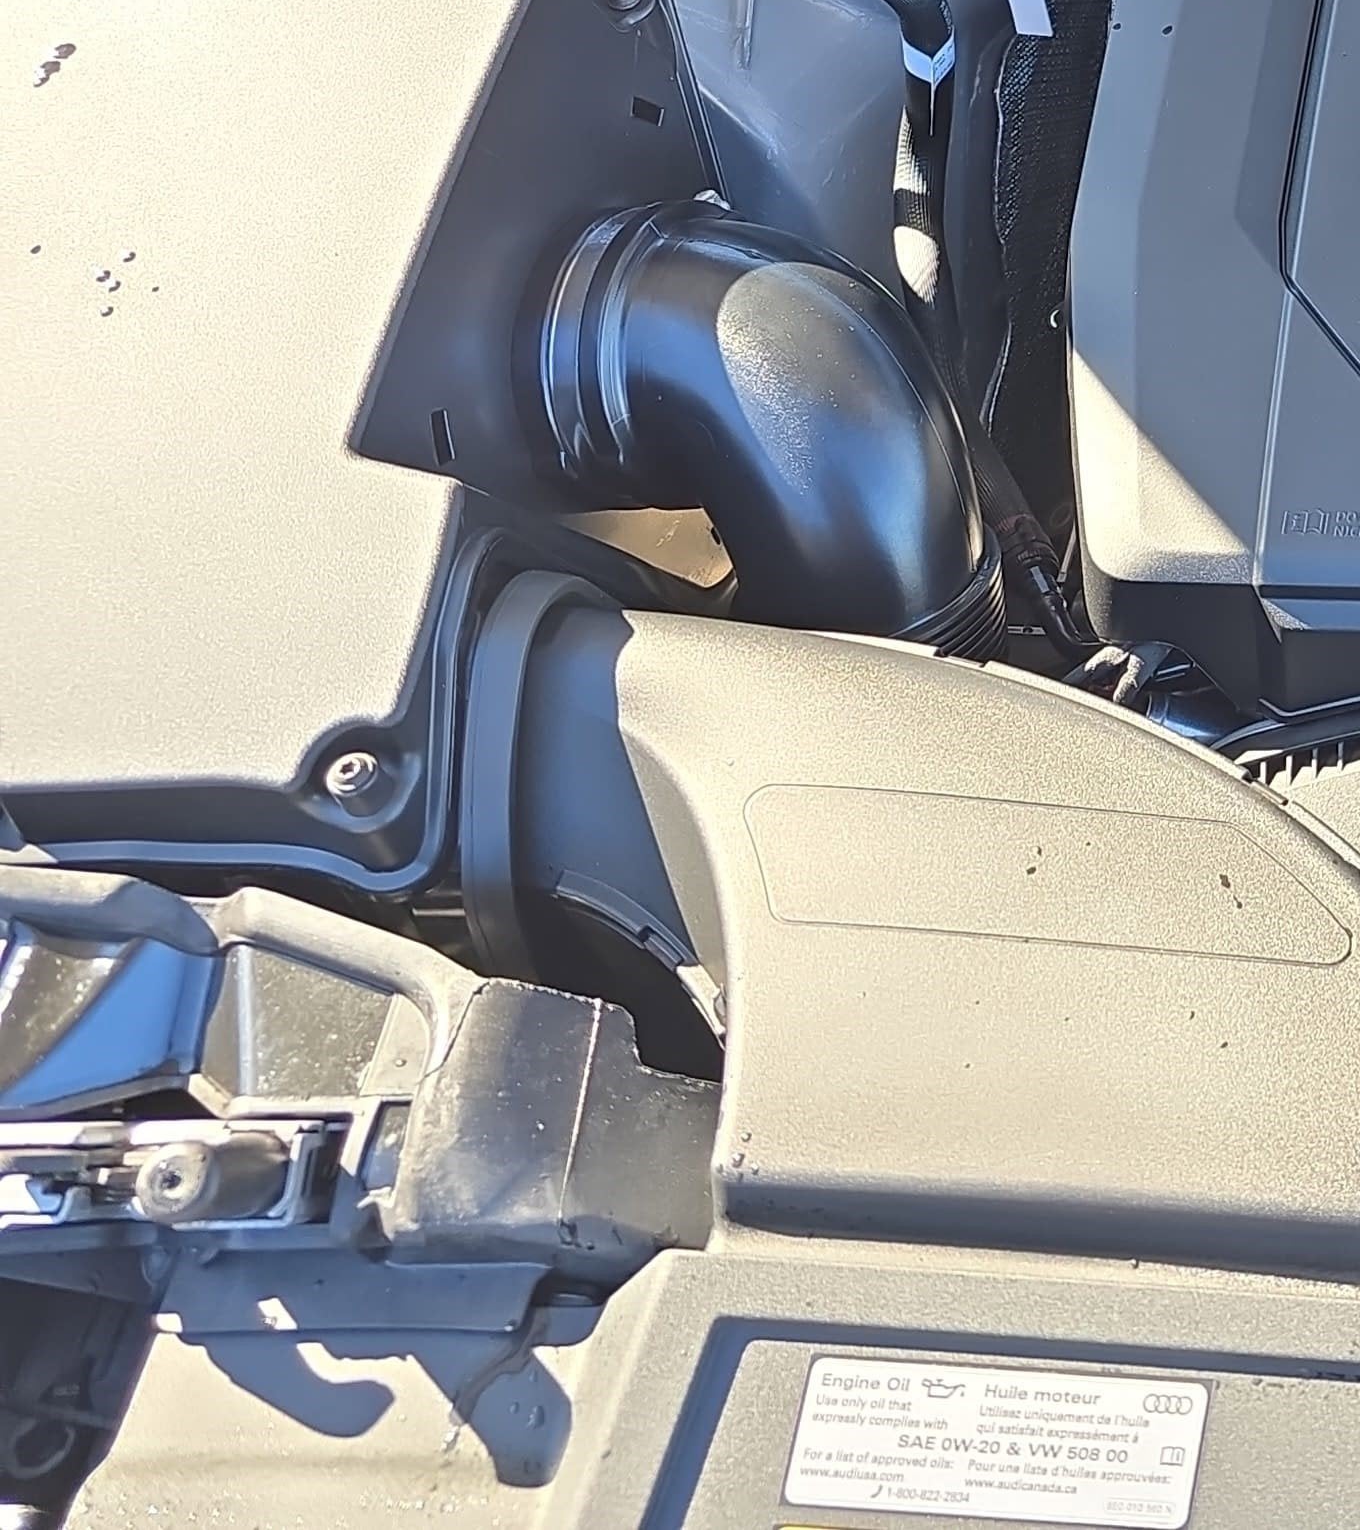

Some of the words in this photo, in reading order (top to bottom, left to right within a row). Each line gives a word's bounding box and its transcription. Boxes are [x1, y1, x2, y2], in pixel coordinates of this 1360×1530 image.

[1335, 511, 1357, 524] DO
[821, 1373, 881, 1391] Engine
[887, 1376, 911, 1392] Oil
[816, 1394, 838, 1407] Use
[841, 1398, 866, 1410] only
[870, 1398, 886, 1409] oil
[888, 1400, 913, 1412] that
[984, 1384, 1028, 1401] Huile
[1034, 1389, 1101, 1405] moteur
[812, 1412, 866, 1427] expressly
[869, 1415, 921, 1431] complies
[923, 1419, 949, 1431] with
[979, 1405, 1022, 1420] Utilisez
[1024, 1408, 1095, 1427] uniquement
[1097, 1413, 1112, 1426] de
[976, 1422, 996, 1436] qui
[998, 1424, 1044, 1438] satisfait
[897, 1433, 937, 1450] SAE
[941, 1436, 1001, 1455] 0W-20
[1006, 1442, 1021, 1456] &
[1028, 1443, 1062, 1459] VW
[1067, 1446, 1100, 1461] 508
[1106, 1449, 1129, 1463] 00
[803, 1447, 822, 1460] For
[836, 1449, 854, 1463] list
[856, 1451, 870, 1464] of
[870, 1454, 928, 1469] approved
[930, 1458, 955, 1470] oils:
[968, 1459, 996, 1472] Pour
[998, 1463, 1020, 1474] une
[1023, 1464, 1048, 1476] liste
[800, 1467, 904, 1483] www.audiusa.com
[964, 1477, 1078, 1495] www.audicanada.ca
